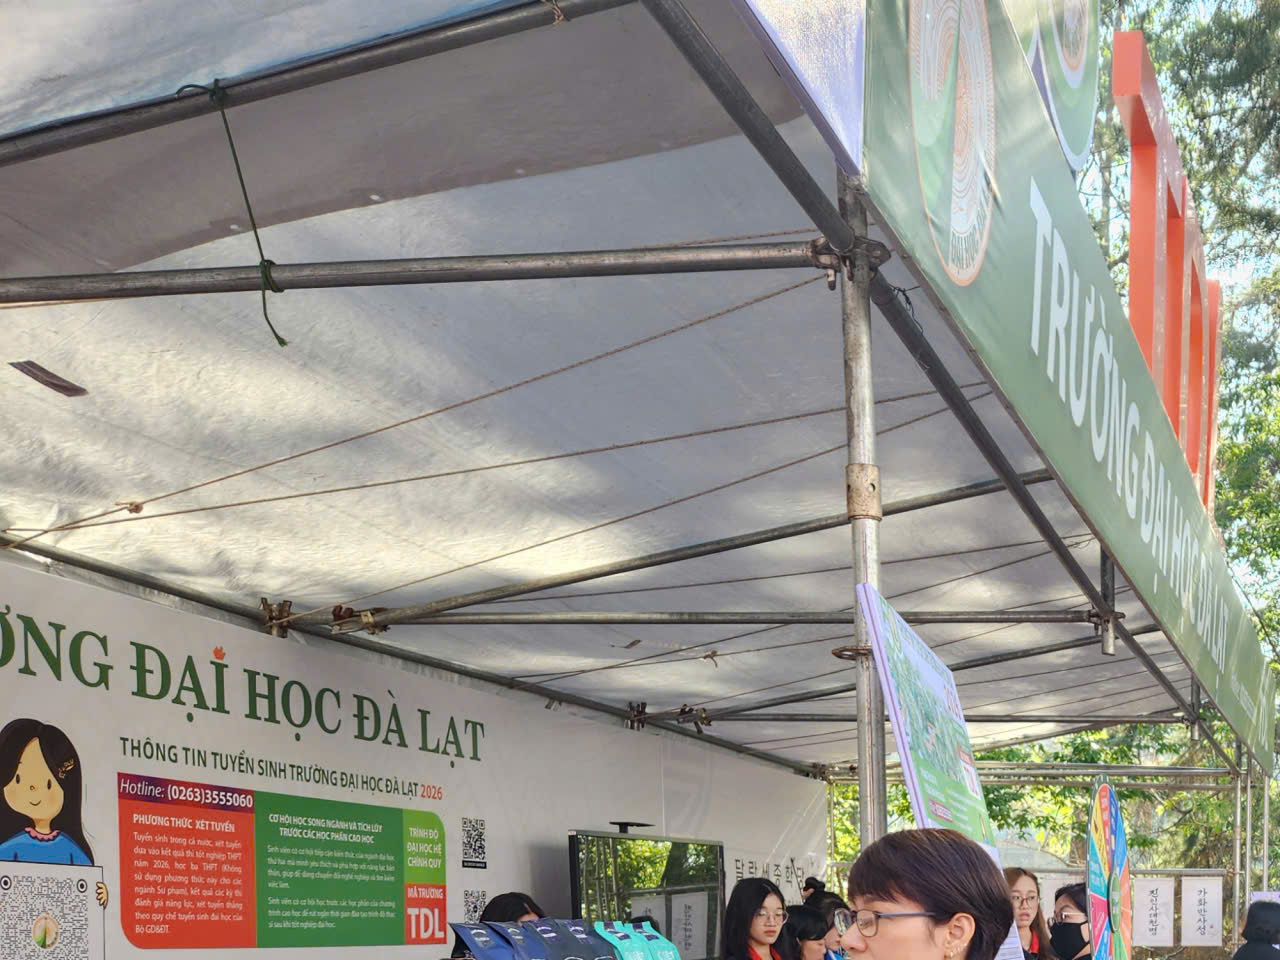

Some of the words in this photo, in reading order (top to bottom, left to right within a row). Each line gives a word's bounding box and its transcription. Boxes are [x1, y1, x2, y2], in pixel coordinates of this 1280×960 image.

[1030, 176, 1139, 518] TRƯỜNG
[1141, 431, 1172, 594] ĐẠI
[1170, 496, 1199, 634] HỌC
[130, 641, 230, 722] ĐẠI
[243, 668, 341, 742] HỌC
[353, 689, 408, 748] ĐÀ
[417, 708, 485, 768] LẠT
[120, 737, 178, 764] THÔNG
[182, 747, 207, 768] TIN
[212, 751, 254, 775] TUYỂN
[258, 759, 287, 779] SINH
[289, 764, 337, 786] TRƯỜNG
[340, 773, 358, 792] ĐẠI
[361, 776, 383, 795] HỌC
[386, 776, 399, 794] ĐÀ
[401, 782, 418, 800] LẠT
[421, 784, 443, 800] 2026
[120, 778, 165, 798] Hotline:
[168, 784, 253, 807] (0263)3555060
[133, 813, 169, 827] PHƯƠNG
[171, 815, 192, 828] THỨC
[407, 907, 444, 939] TDL
